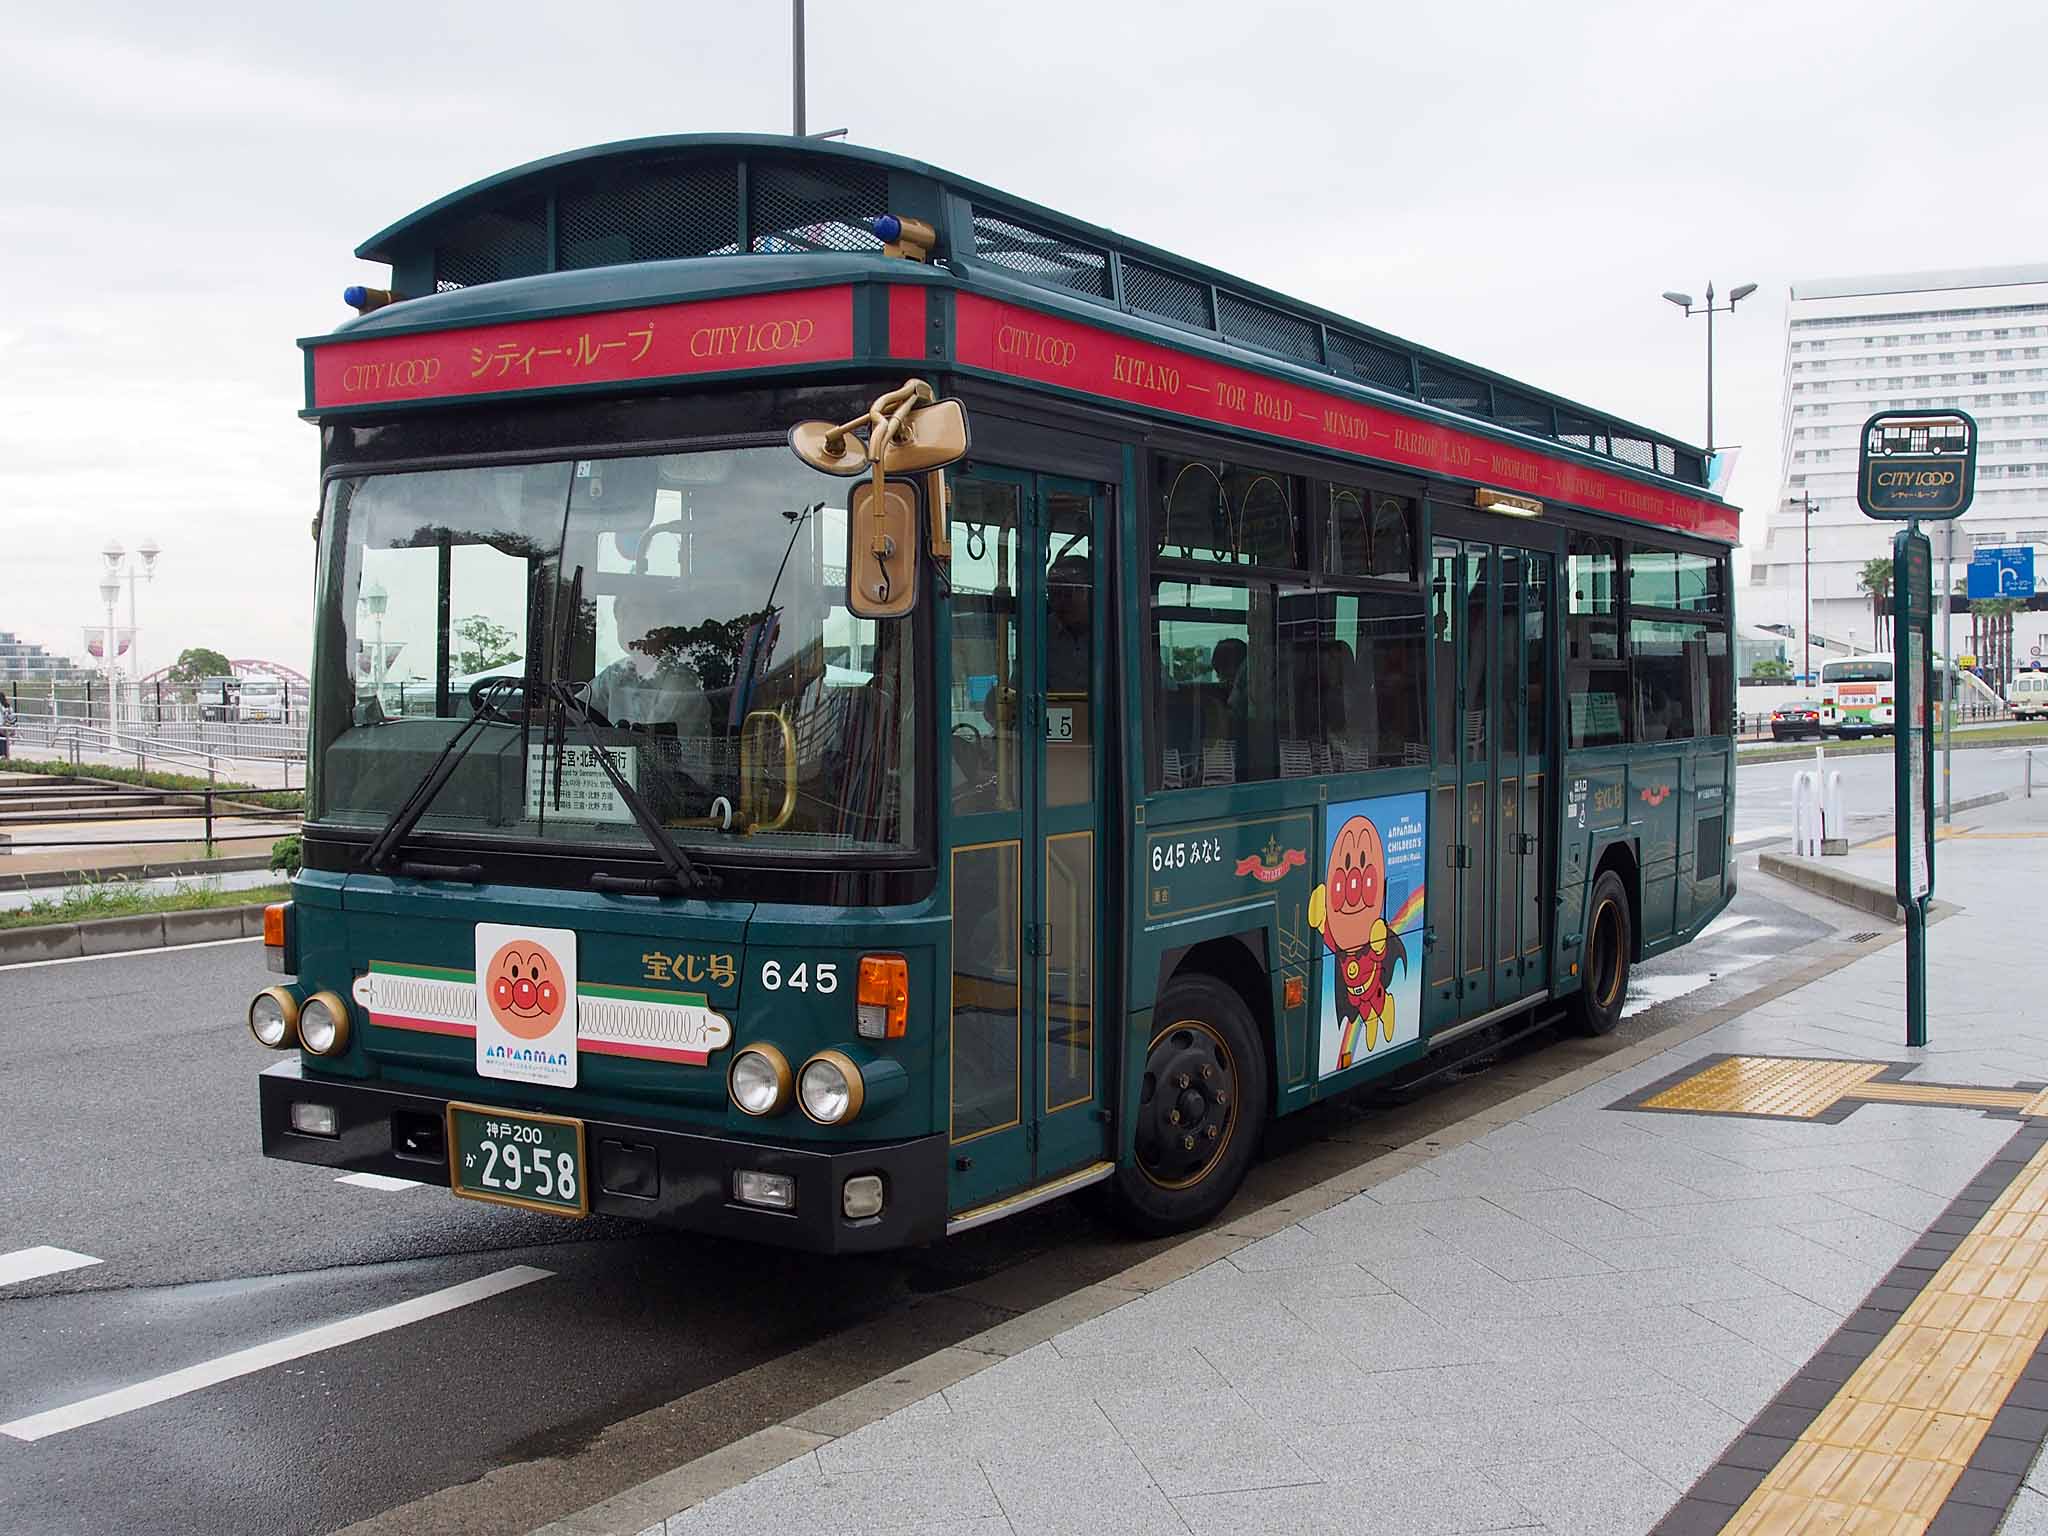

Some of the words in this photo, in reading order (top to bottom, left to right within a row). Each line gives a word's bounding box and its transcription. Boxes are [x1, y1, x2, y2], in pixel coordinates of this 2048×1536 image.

[472, 322, 655, 378] シティー・ループ
[691, 326, 744, 358] CITY
[745, 319, 814, 352] LOOP
[999, 326, 1034, 358] CITY
[1035, 335, 1076, 367] LOOP
[343, 363, 386, 392] CITY
[386, 358, 441, 388] LOOP
[1112, 354, 1180, 395] KITANO
[1217, 382, 1247, 411] TOR
[1253, 392, 1293, 422] ROAD
[1322, 410, 1369, 440] MINATO
[1878, 472, 1915, 486] CITY
[1915, 472, 1955, 486] LOOP
[1152, 842, 1186, 872] 645
[1190, 838, 1221, 865] みなと
[642, 951, 737, 988] 宝くじ号
[762, 960, 838, 994] 645
[465, 1153, 477, 1168] か
[480, 1140, 576, 1200] 29-58
